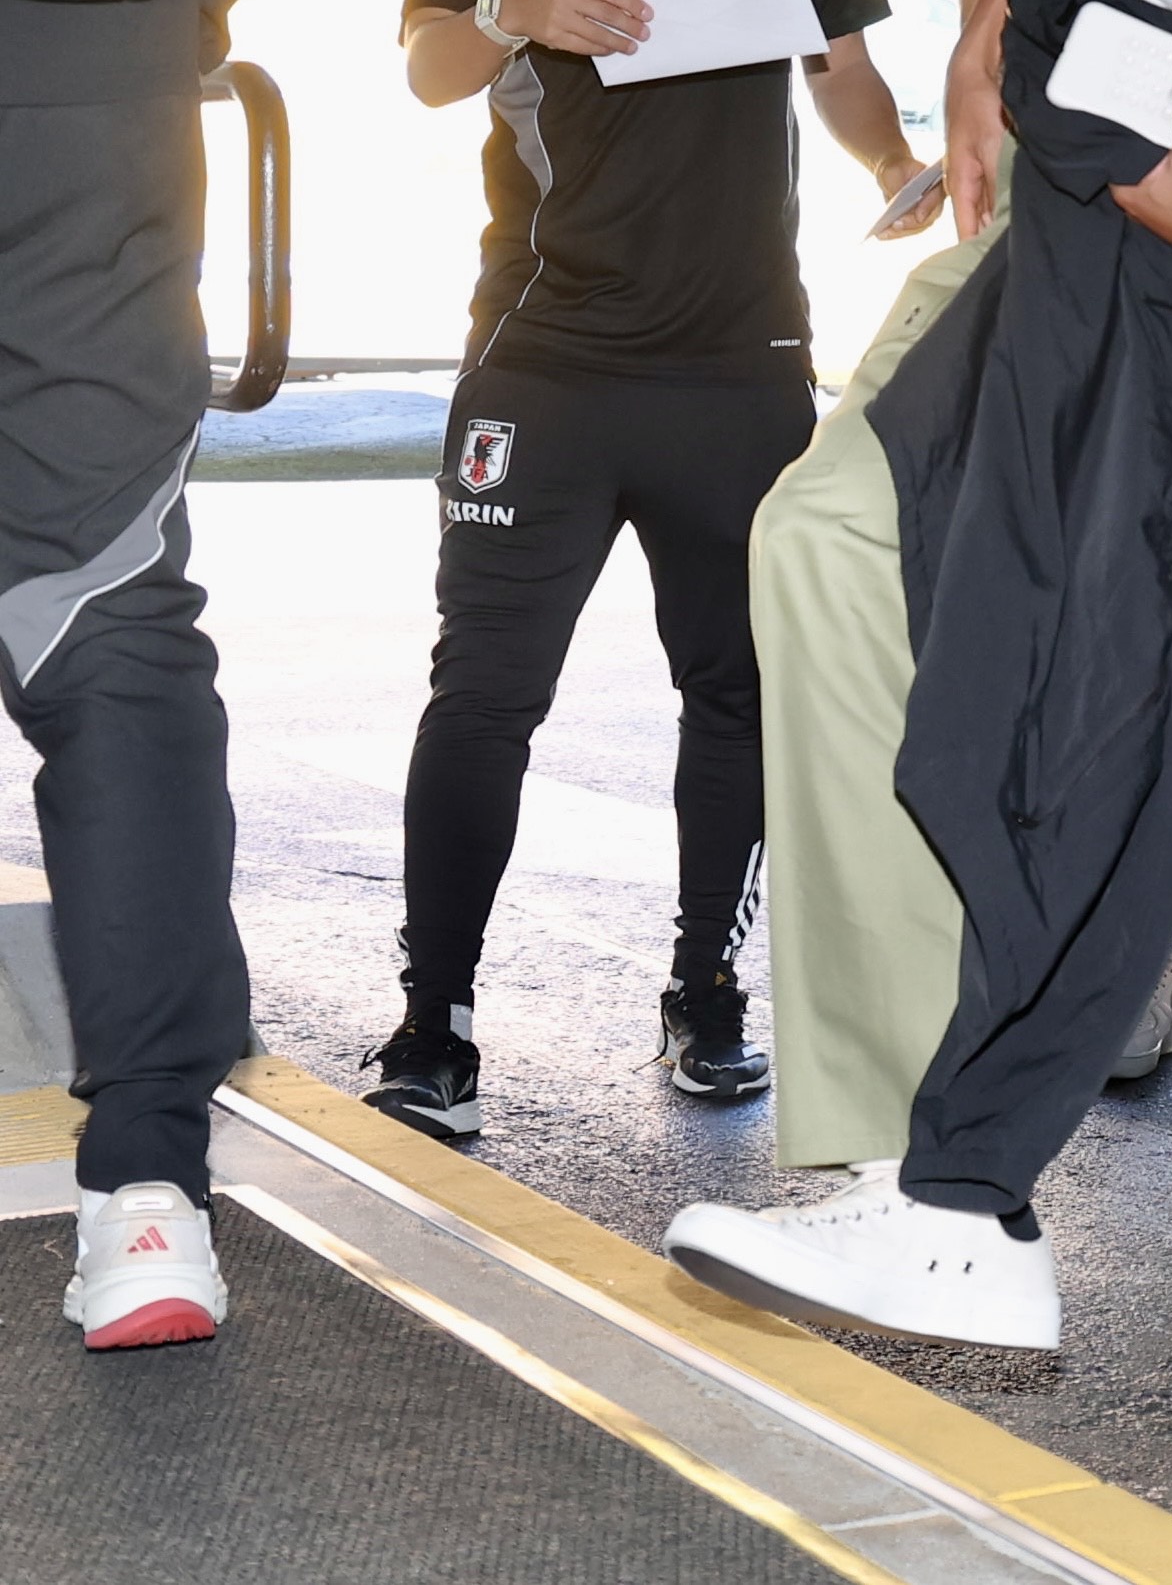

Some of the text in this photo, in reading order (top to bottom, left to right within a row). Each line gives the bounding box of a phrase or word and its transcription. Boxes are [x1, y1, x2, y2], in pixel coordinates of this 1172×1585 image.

[473, 423, 502, 432] JAPAN
[465, 467, 489, 481] JFA
[446, 499, 516, 527] IRIN
